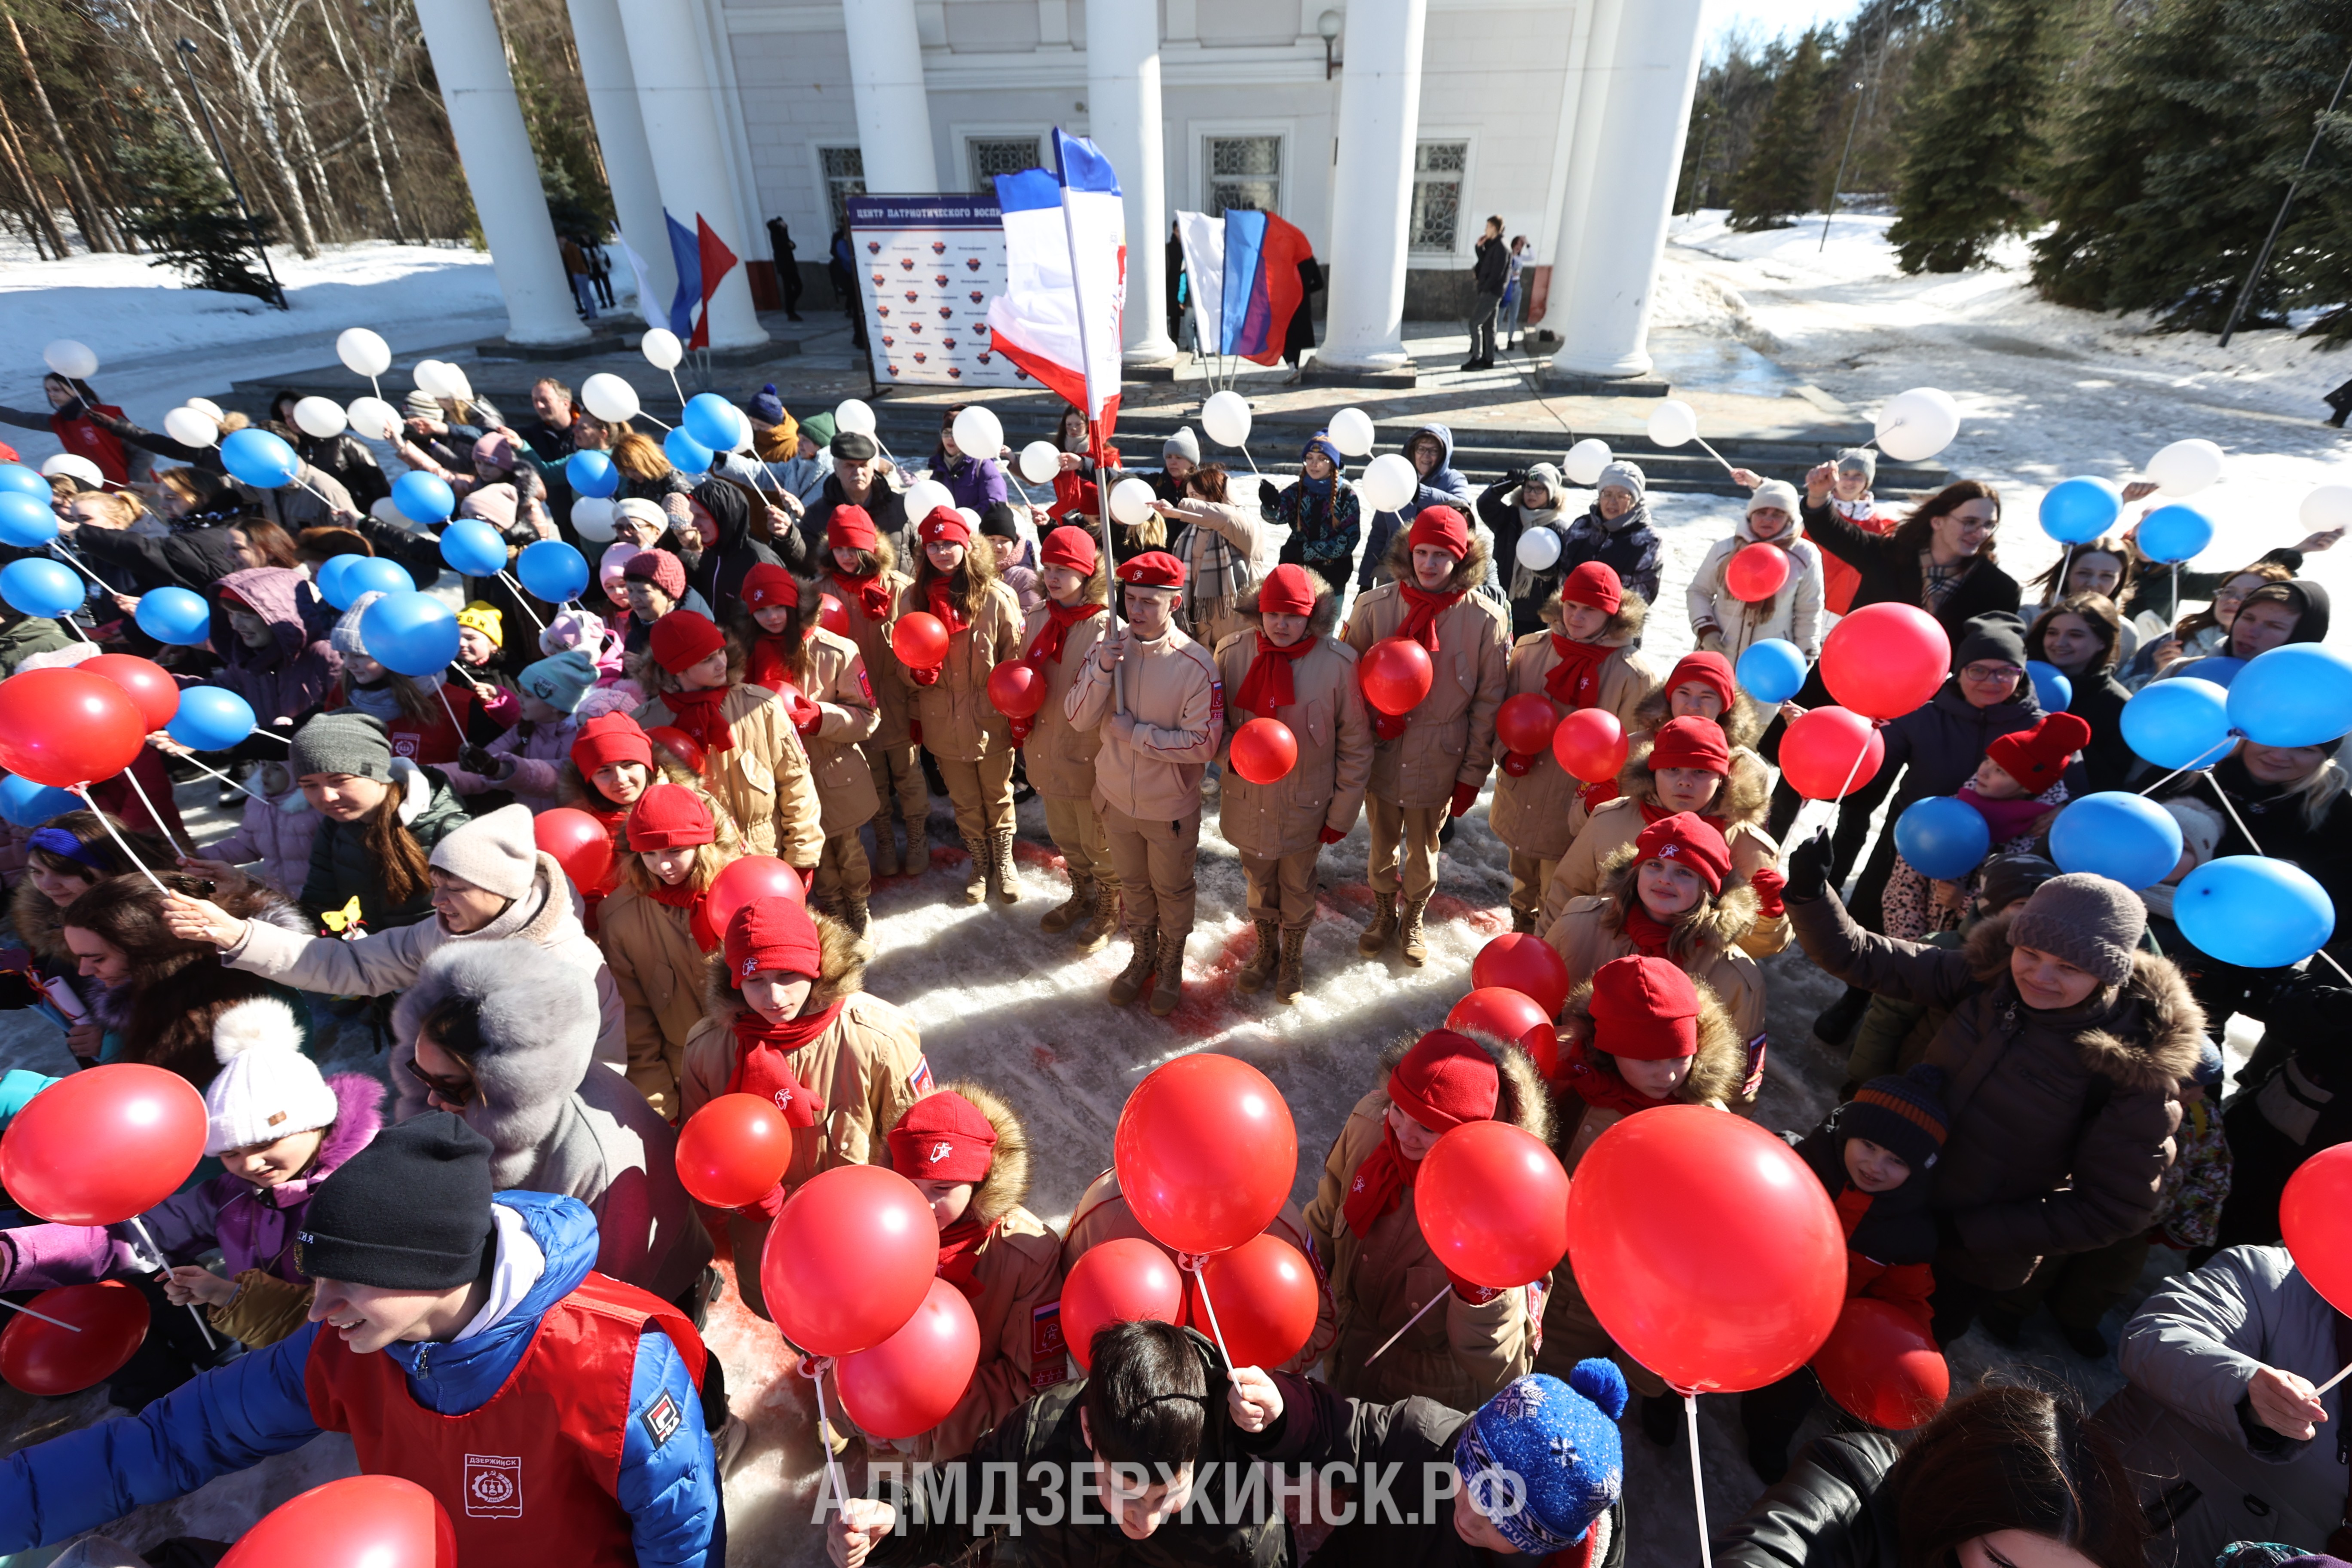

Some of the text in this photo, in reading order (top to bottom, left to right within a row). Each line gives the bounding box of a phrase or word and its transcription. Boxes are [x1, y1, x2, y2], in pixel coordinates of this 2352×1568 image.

[856, 208, 884, 220] ЦЕНТР
[888, 208, 971, 218] ПАТРИОТИЧЕСКОГО
[658, 1417, 680, 1442] FILA
[469, 1457, 517, 1467] ДЗЕРЖИНСК
